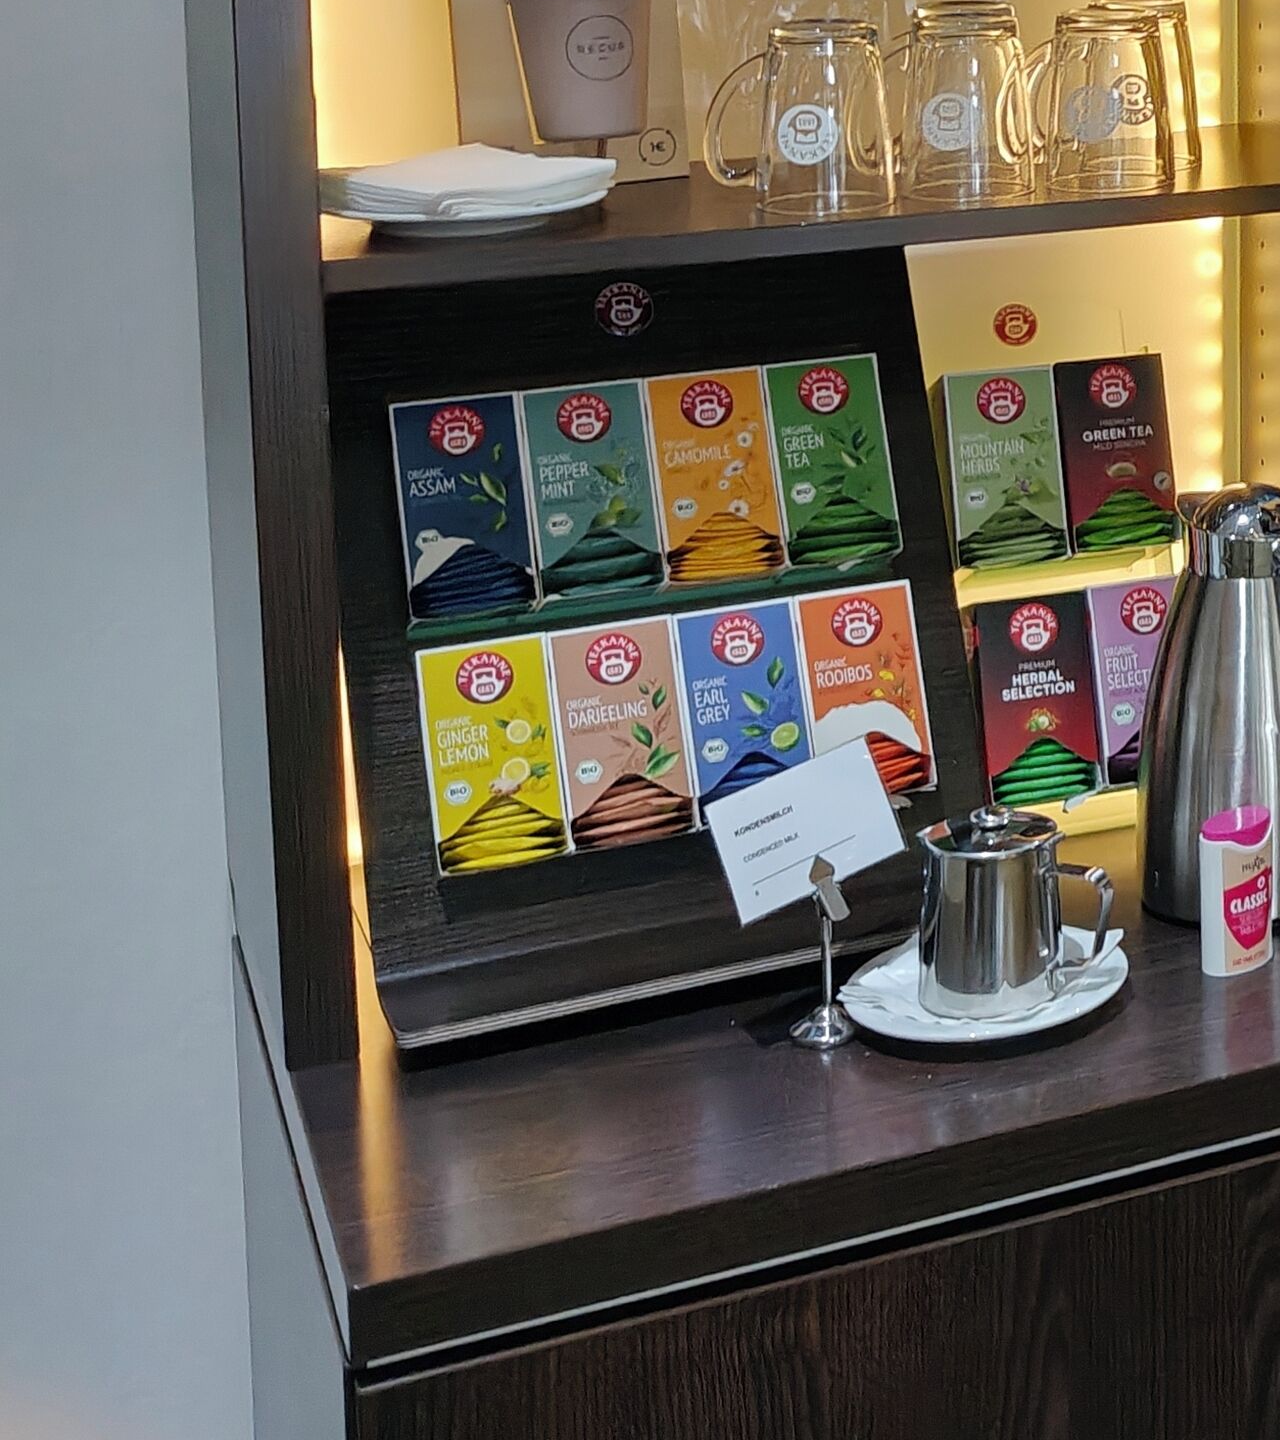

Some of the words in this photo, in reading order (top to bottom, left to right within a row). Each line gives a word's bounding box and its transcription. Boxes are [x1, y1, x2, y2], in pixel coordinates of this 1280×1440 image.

[783, 433, 825, 452] GREEN
[1082, 426, 1126, 443] GREEN
[1129, 425, 1154, 438] TEA
[664, 443, 732, 469] CAMOMILE
[960, 439, 1025, 459] MOUNTAIN
[785, 452, 811, 469] TEA
[961, 458, 1001, 475] HERBS
[539, 461, 591, 483] PEPPER
[409, 476, 456, 498] ASSAM
[541, 480, 576, 500] MINT
[833, 599, 881, 629] TEEKANNE
[713, 617, 763, 647] TEEKANNE
[587, 635, 640, 666] TEEKANNE
[458, 653, 512, 685] TEEKANNE
[1105, 654, 1138, 674] FRUIT
[816, 663, 873, 689] ROOIBOS
[1012, 668, 1064, 687] HERBAL
[694, 687, 729, 709] EARL
[1002, 679, 1076, 702] SELECTION
[568, 700, 648, 729] DARJEELING
[697, 704, 730, 726] GREY
[437, 724, 489, 749] GINGER
[439, 742, 490, 767] LEMON
[1229, 889, 1268, 915] CLASSIC
